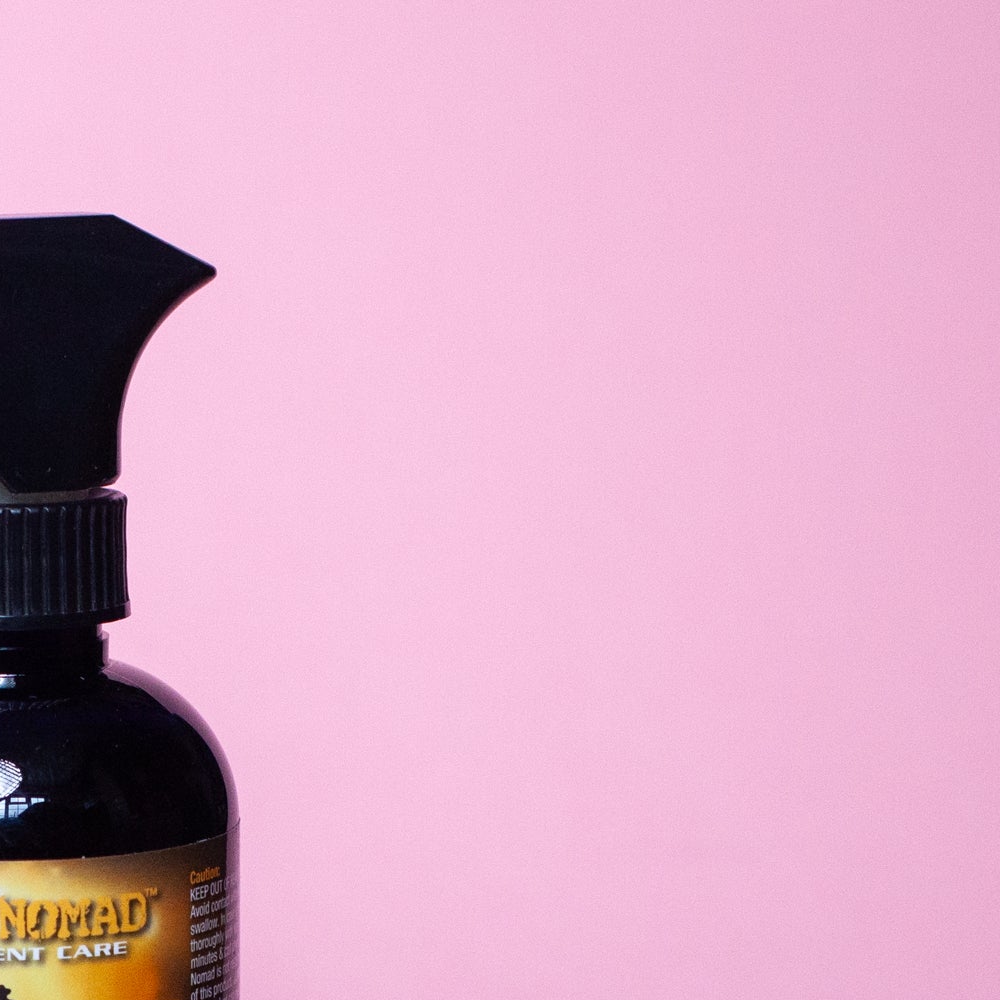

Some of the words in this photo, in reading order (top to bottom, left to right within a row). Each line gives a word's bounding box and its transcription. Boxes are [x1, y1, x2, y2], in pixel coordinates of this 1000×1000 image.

[190, 884, 209, 902] KEEP
[210, 879, 222, 896] OUT
[190, 901, 210, 919] Avoid
[190, 917, 220, 936] swallow.
[57, 940, 128, 962] CARE
[190, 951, 218, 969] minutes
[190, 966, 216, 987] Nomad
[200, 985, 213, 1000] this
